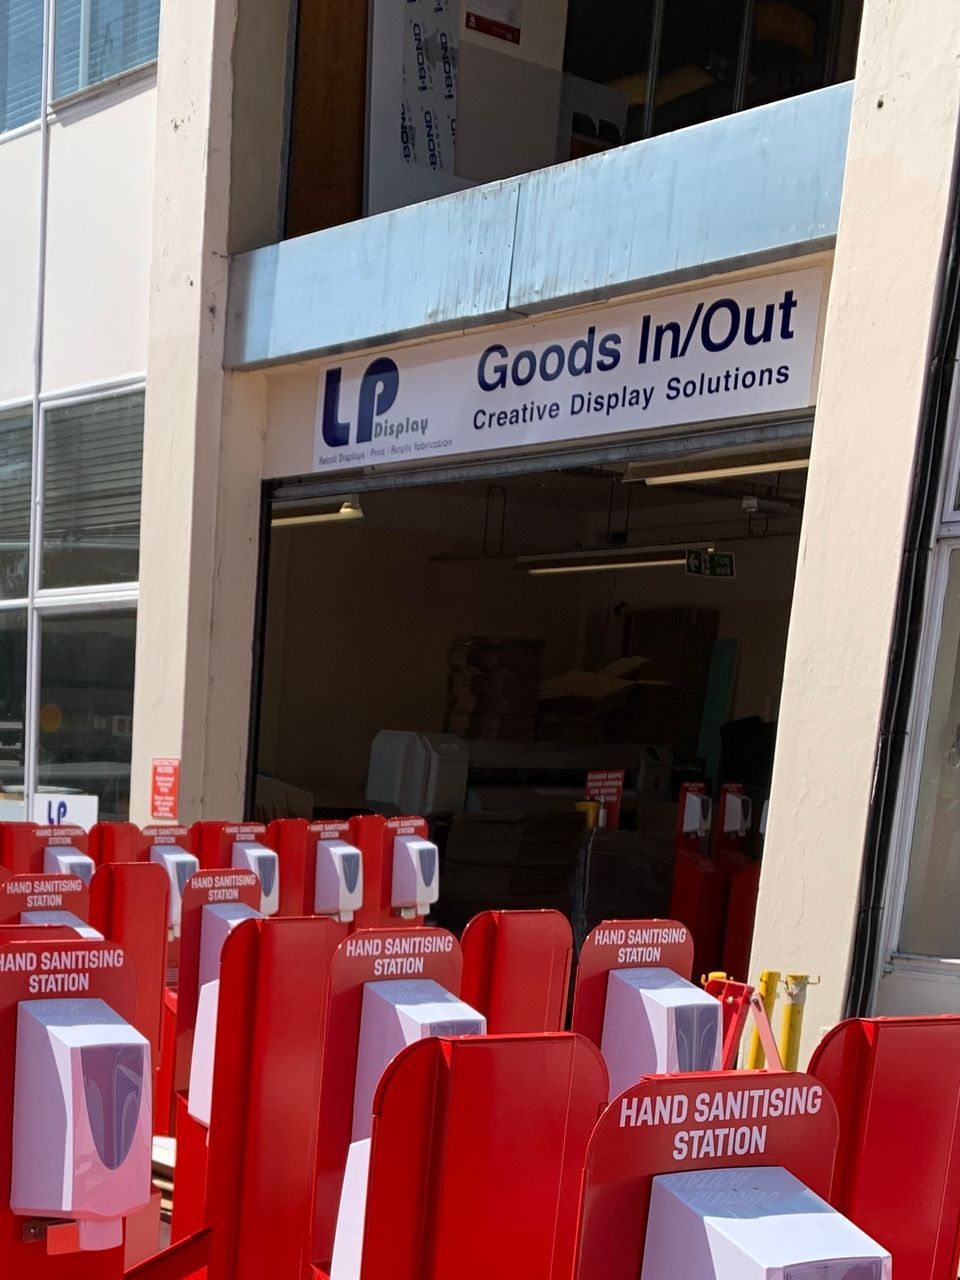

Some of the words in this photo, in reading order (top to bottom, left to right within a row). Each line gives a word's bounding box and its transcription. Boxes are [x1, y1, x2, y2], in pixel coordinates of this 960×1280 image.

[477, 326, 622, 392] Goods
[638, 290, 798, 364] In/Out
[322, 356, 400, 447] LP
[473, 401, 560, 430] Creative
[570, 385, 655, 416] Display
[665, 365, 790, 401] Solutions
[374, 417, 429, 439] Display
[48, 800, 67, 825] LP
[7, 881, 31, 894] HAND
[33, 879, 82, 893] SANITISING
[191, 877, 213, 889] HAND
[214, 874, 256, 887] SANITISING
[26, 895, 62, 908] STATION
[208, 889, 239, 901] STATION
[346, 939, 382, 957] HAND
[384, 935, 454, 954] SANITISING
[594, 929, 625, 946] HAND
[628, 928, 687, 944] SANITISING
[40, 949, 124, 970] SANITISING
[617, 947, 661, 963] STATION
[374, 957, 424, 976] STATION
[28, 973, 89, 993] STATION
[619, 1094, 688, 1128] HAND
[694, 1085, 823, 1123] SANITISING
[672, 1125, 767, 1160] STATION
